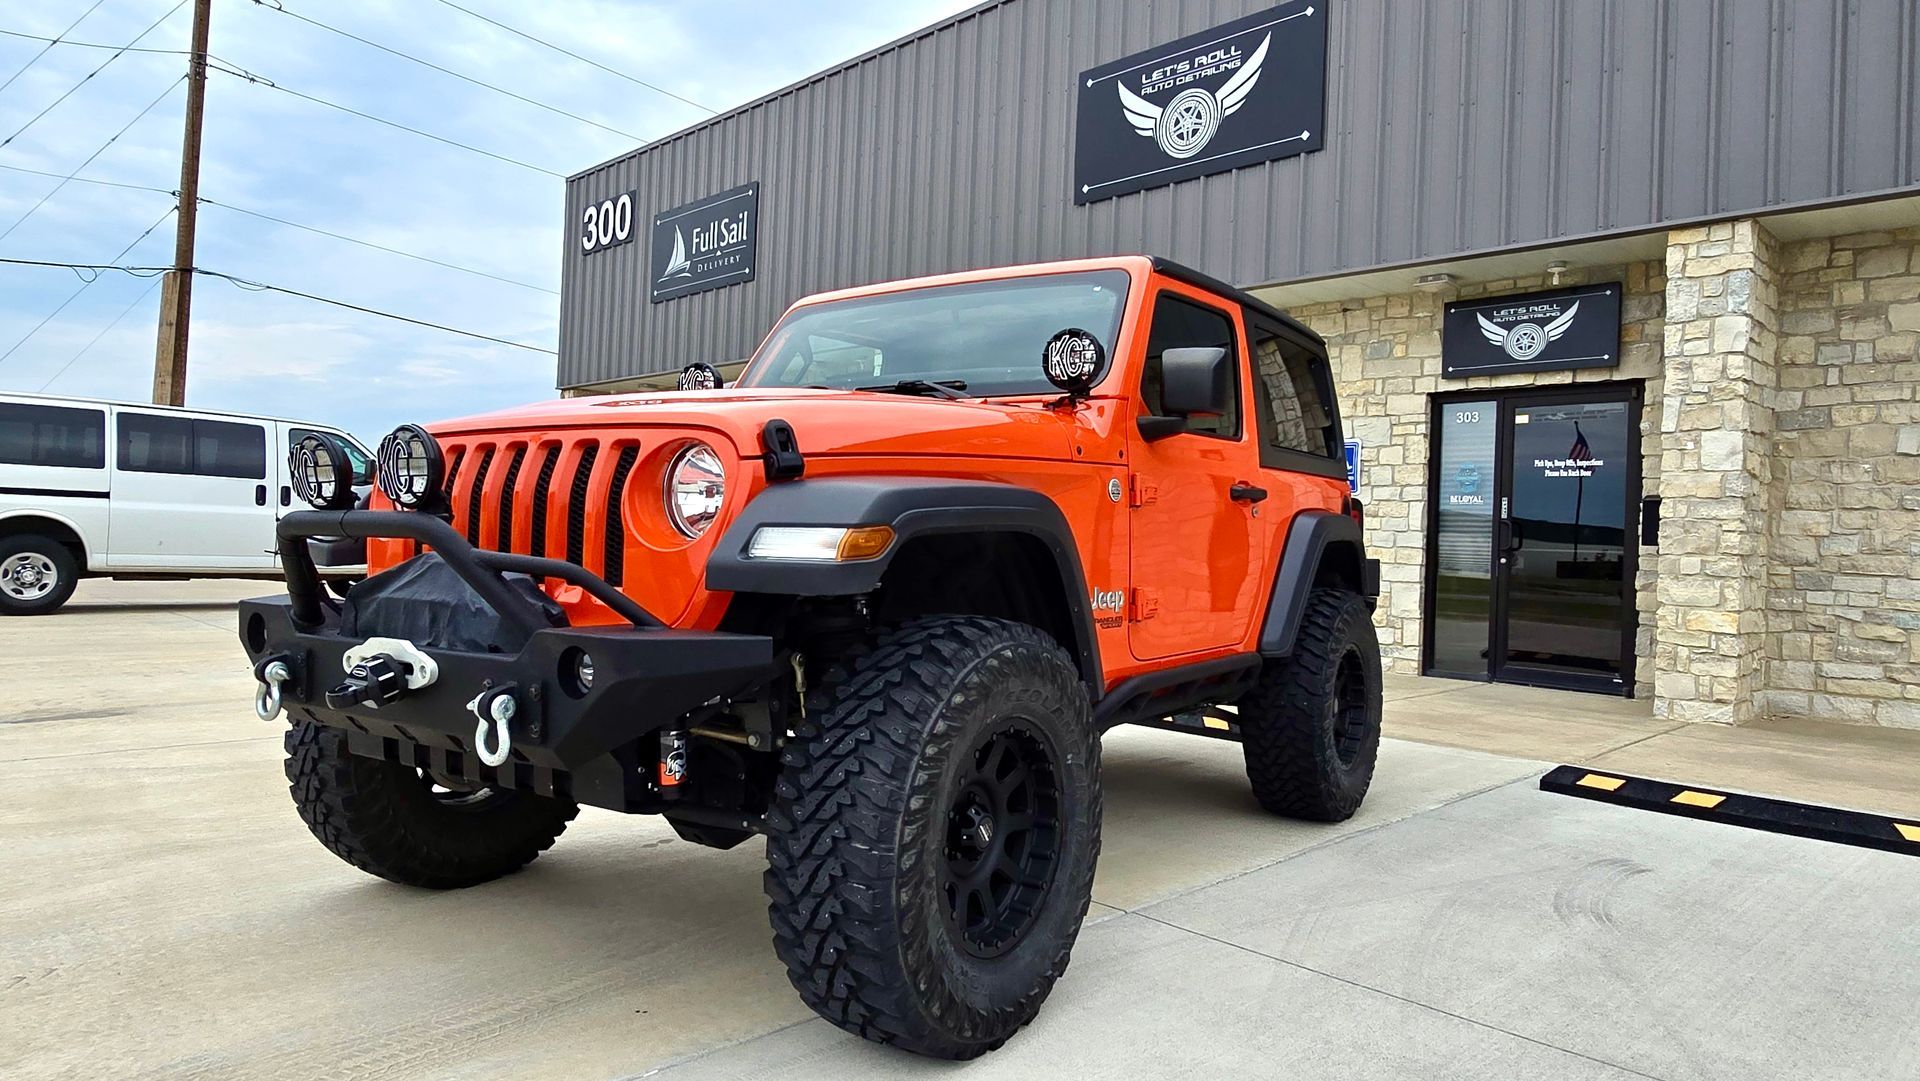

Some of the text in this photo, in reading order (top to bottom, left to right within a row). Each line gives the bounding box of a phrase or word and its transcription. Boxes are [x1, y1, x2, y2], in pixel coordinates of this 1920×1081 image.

[1141, 45, 1242, 84] LET'S ROLL
[1141, 59, 1242, 96] AUTO DETAILING
[582, 193, 632, 251] 300
[692, 210, 748, 255] Full Sail
[697, 254, 741, 273] DELIVERY
[1493, 303, 1561, 316] LET'S ROLL
[1517, 311, 1561, 320] DETAILING
[1048, 334, 1083, 380] KC
[1455, 411, 1480, 424] 303
[288, 444, 318, 502] KC
[377, 434, 409, 500] KC
[1091, 586, 1125, 613] Jeep
